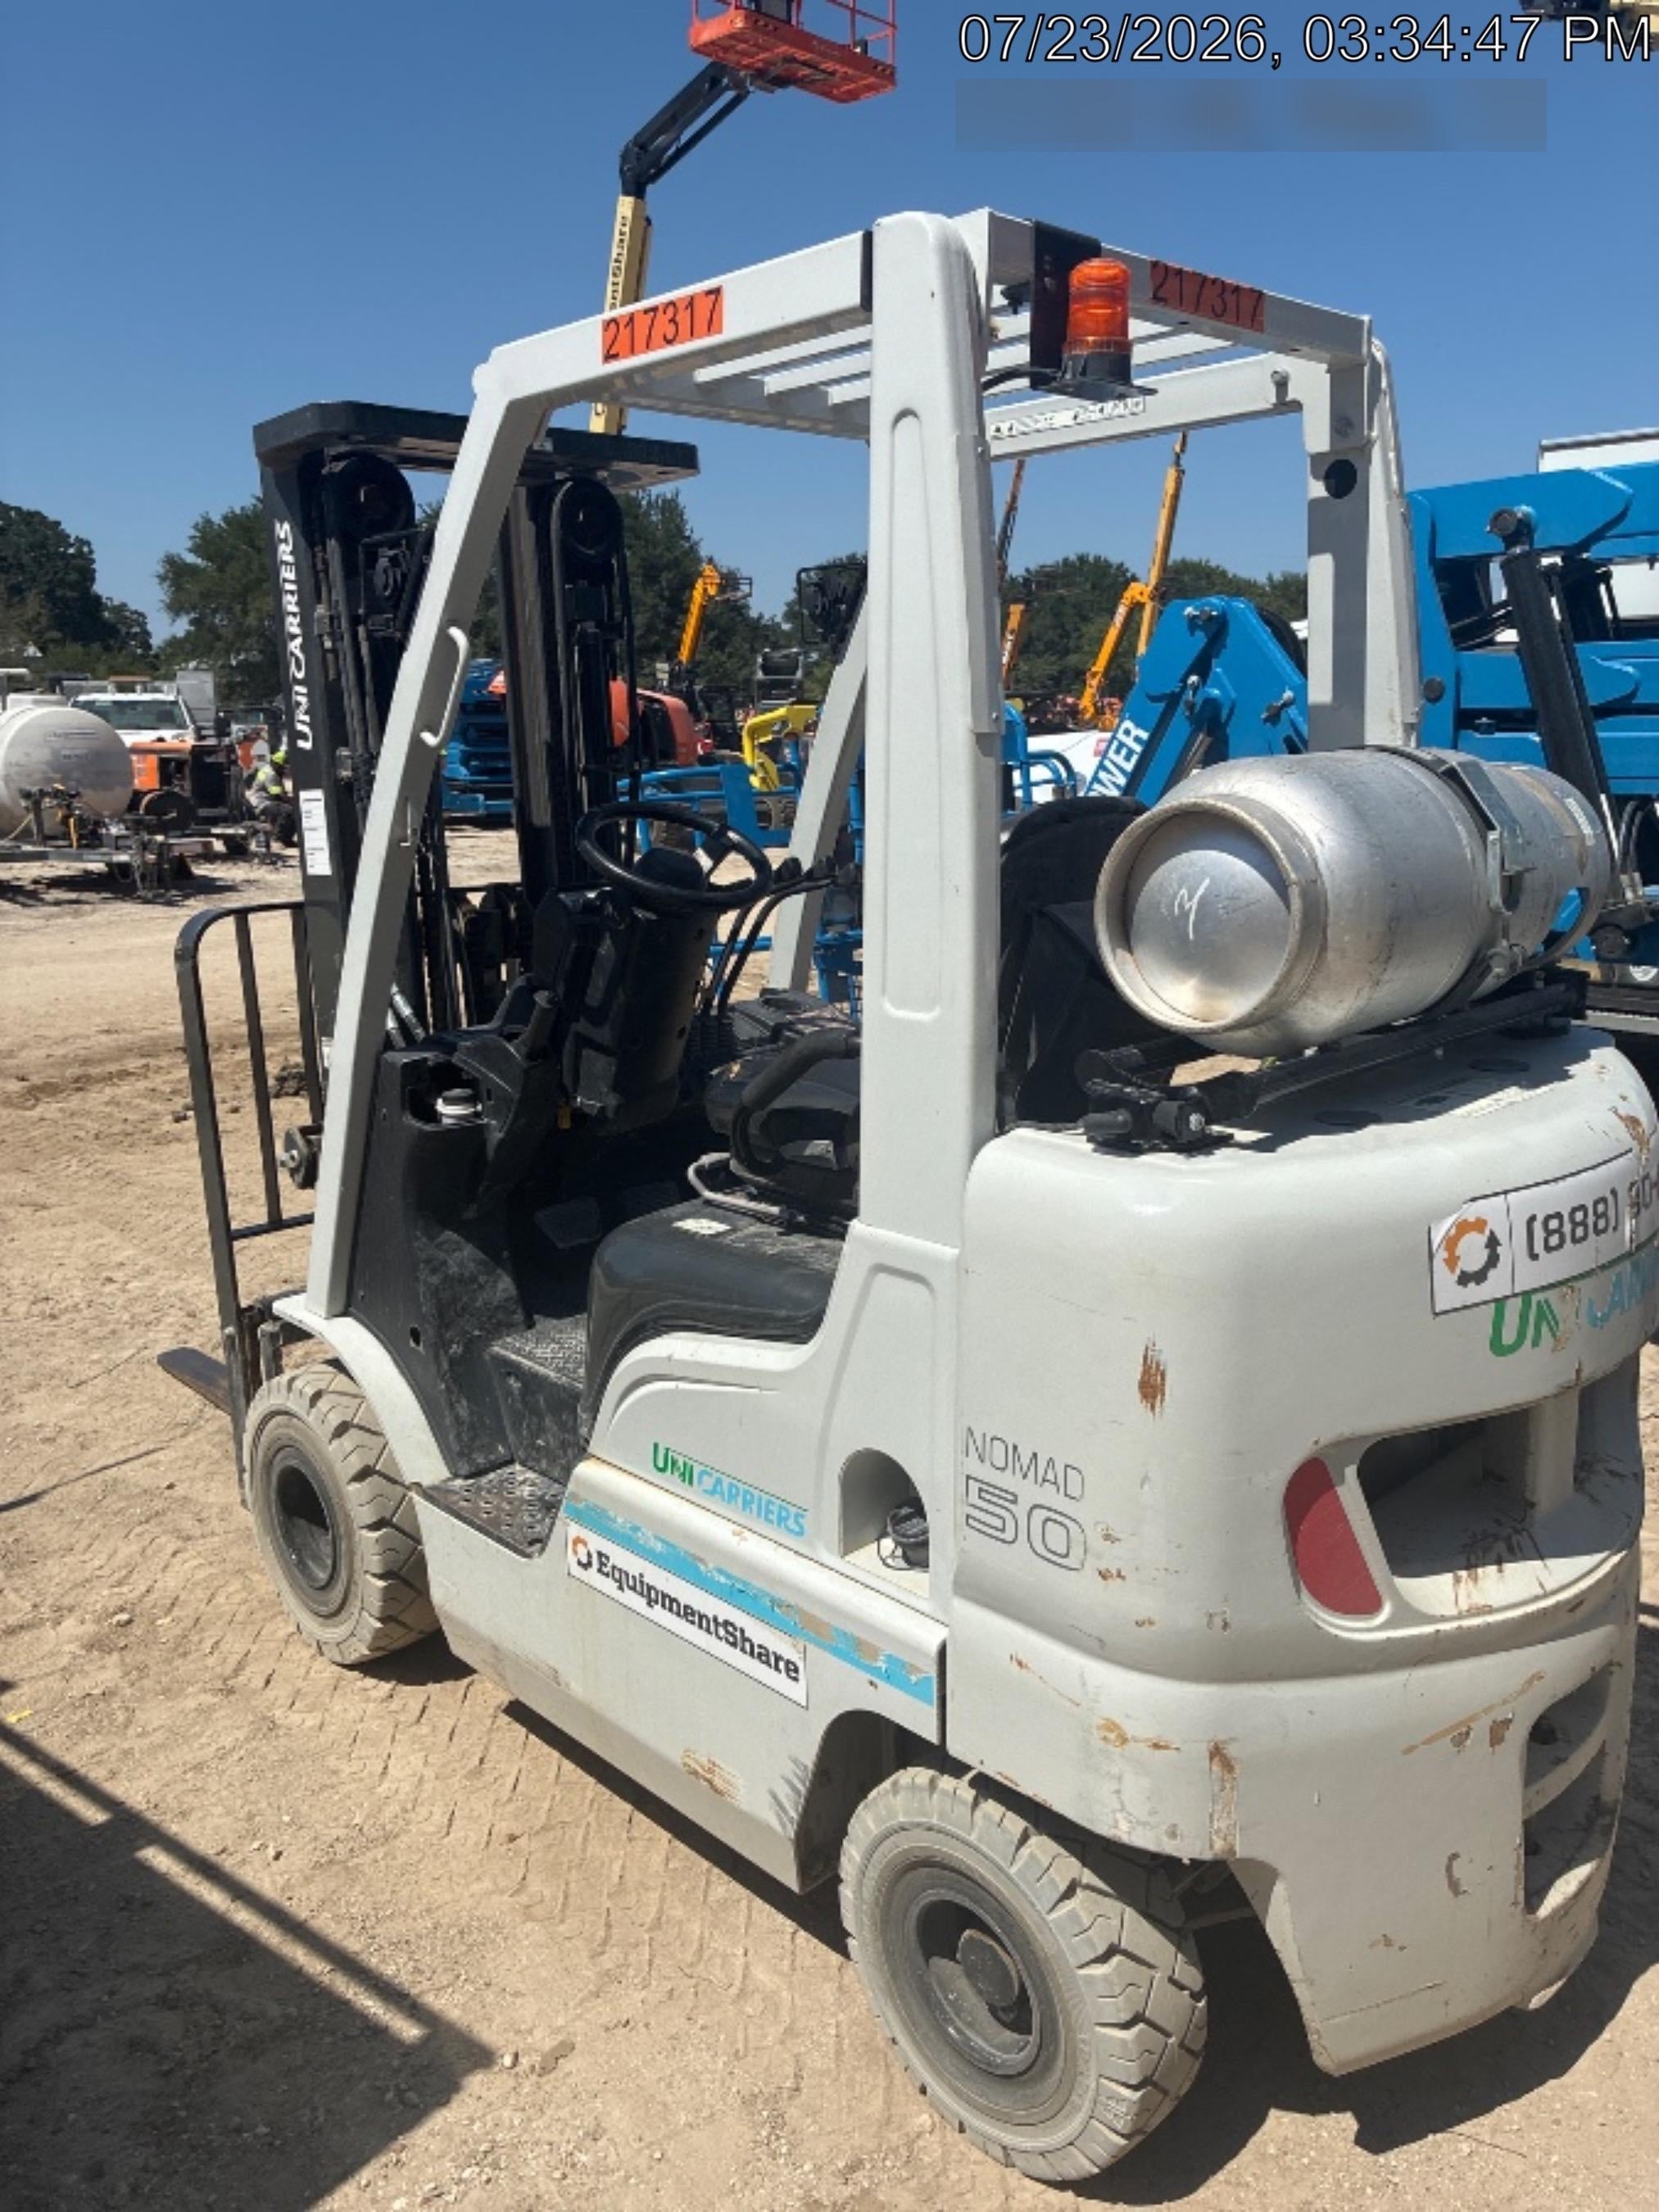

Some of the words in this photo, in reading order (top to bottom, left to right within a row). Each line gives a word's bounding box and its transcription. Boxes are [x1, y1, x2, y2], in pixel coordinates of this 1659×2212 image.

[605, 286, 723, 363] 217317
[1150, 261, 1266, 329] 217317
[1525, 1186, 1619, 1262] (888)
[965, 1426, 1084, 1503] NOMAD
[966, 1474, 1087, 1571] 50
[596, 1550, 800, 1682] EquipmentShare
